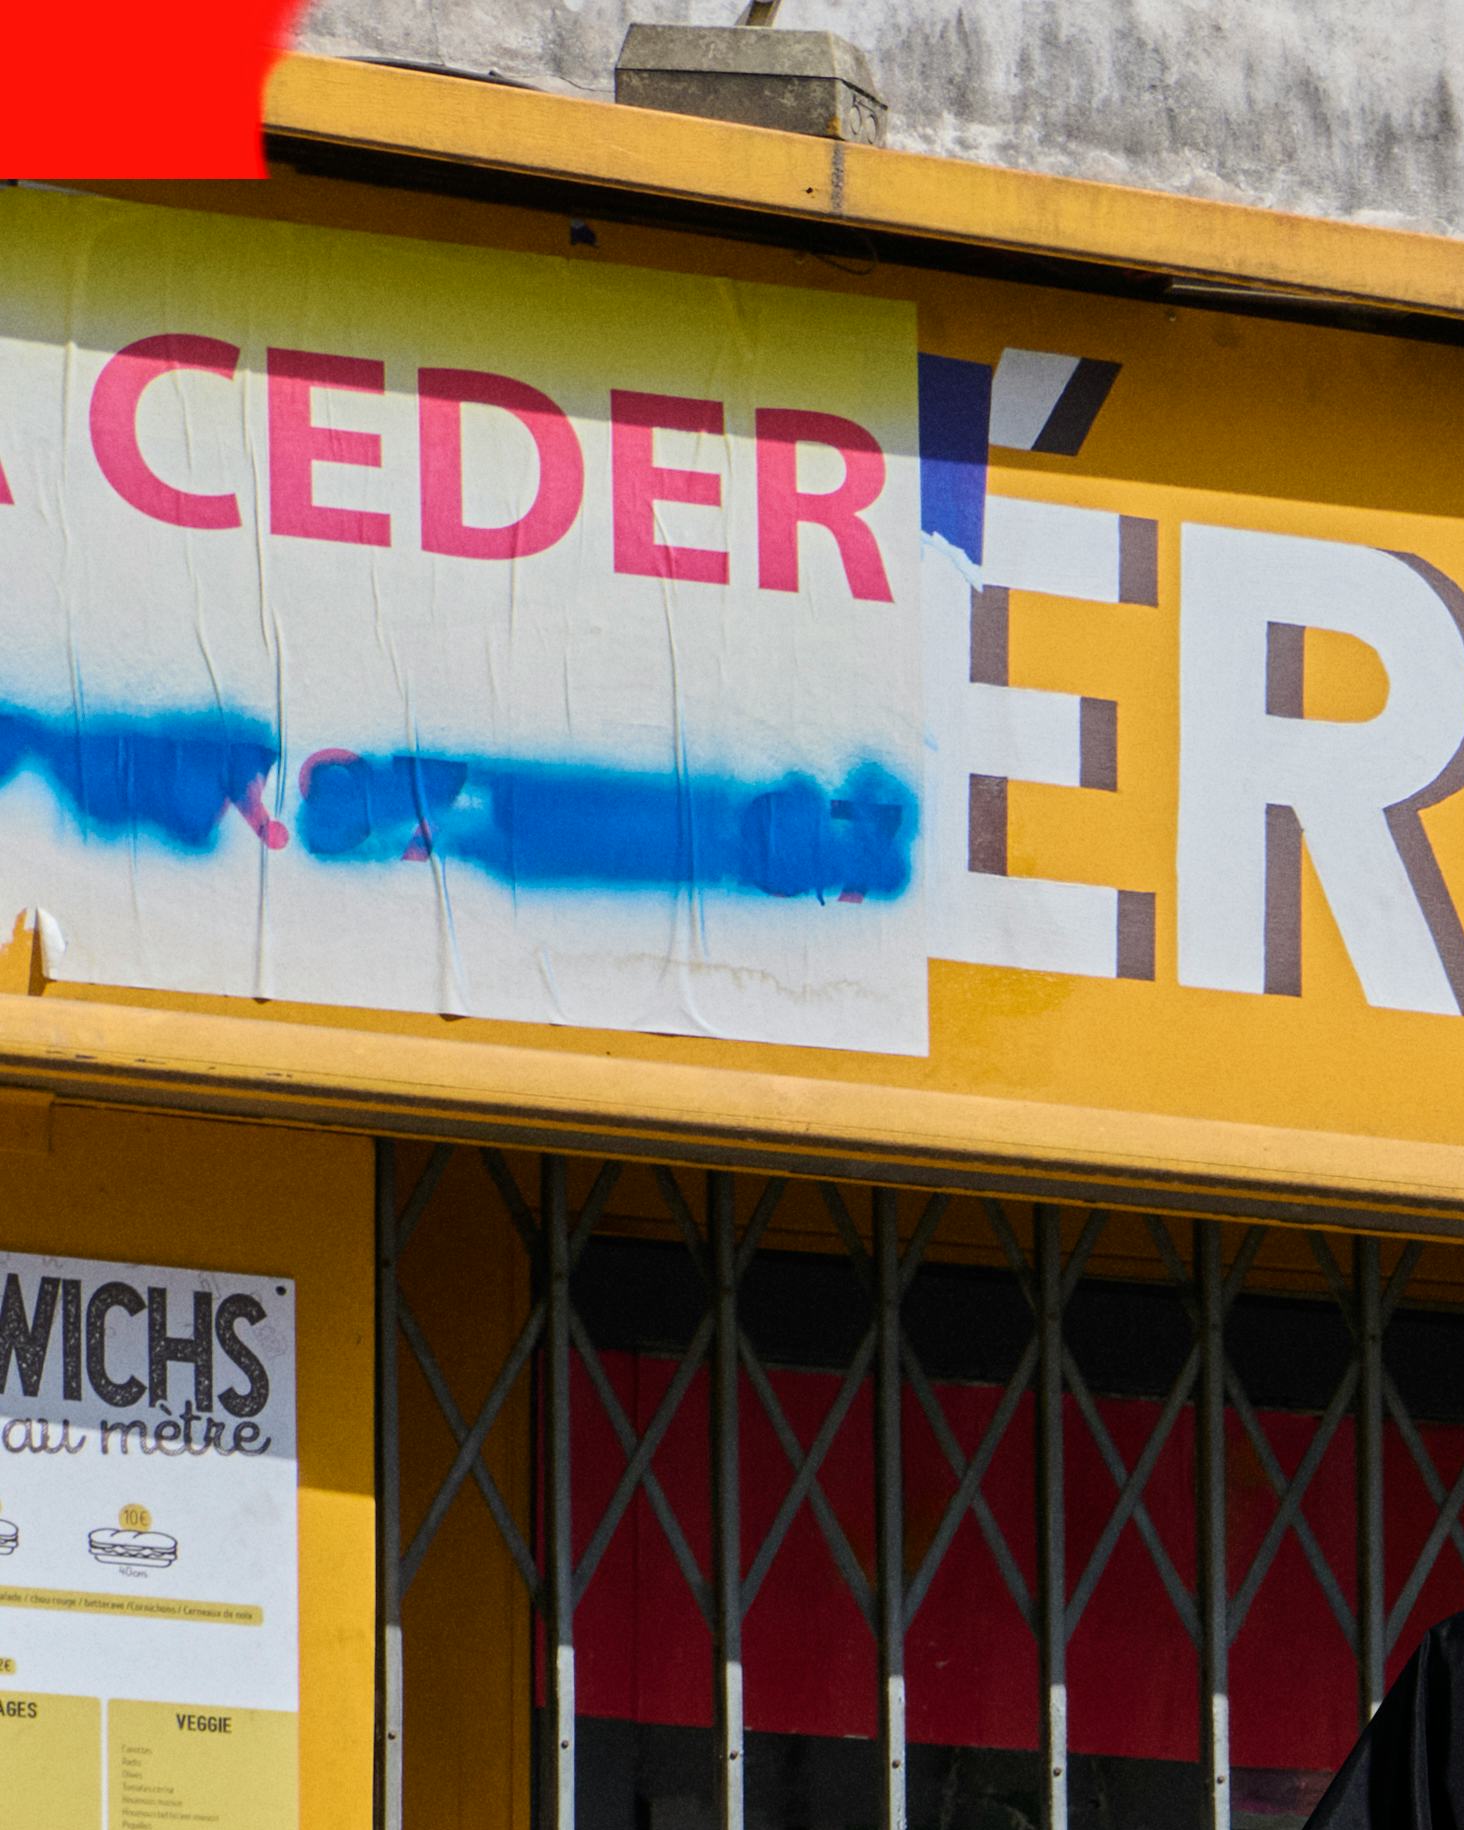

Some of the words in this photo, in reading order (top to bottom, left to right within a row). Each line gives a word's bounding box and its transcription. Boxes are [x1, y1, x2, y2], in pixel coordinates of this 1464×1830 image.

[89, 333, 896, 604] CEDER
[2, 1417, 87, 1454] au
[100, 1400, 272, 1456] mètre
[124, 1508, 149, 1527] 10€
[176, 1713, 232, 1734] VEGGIE
